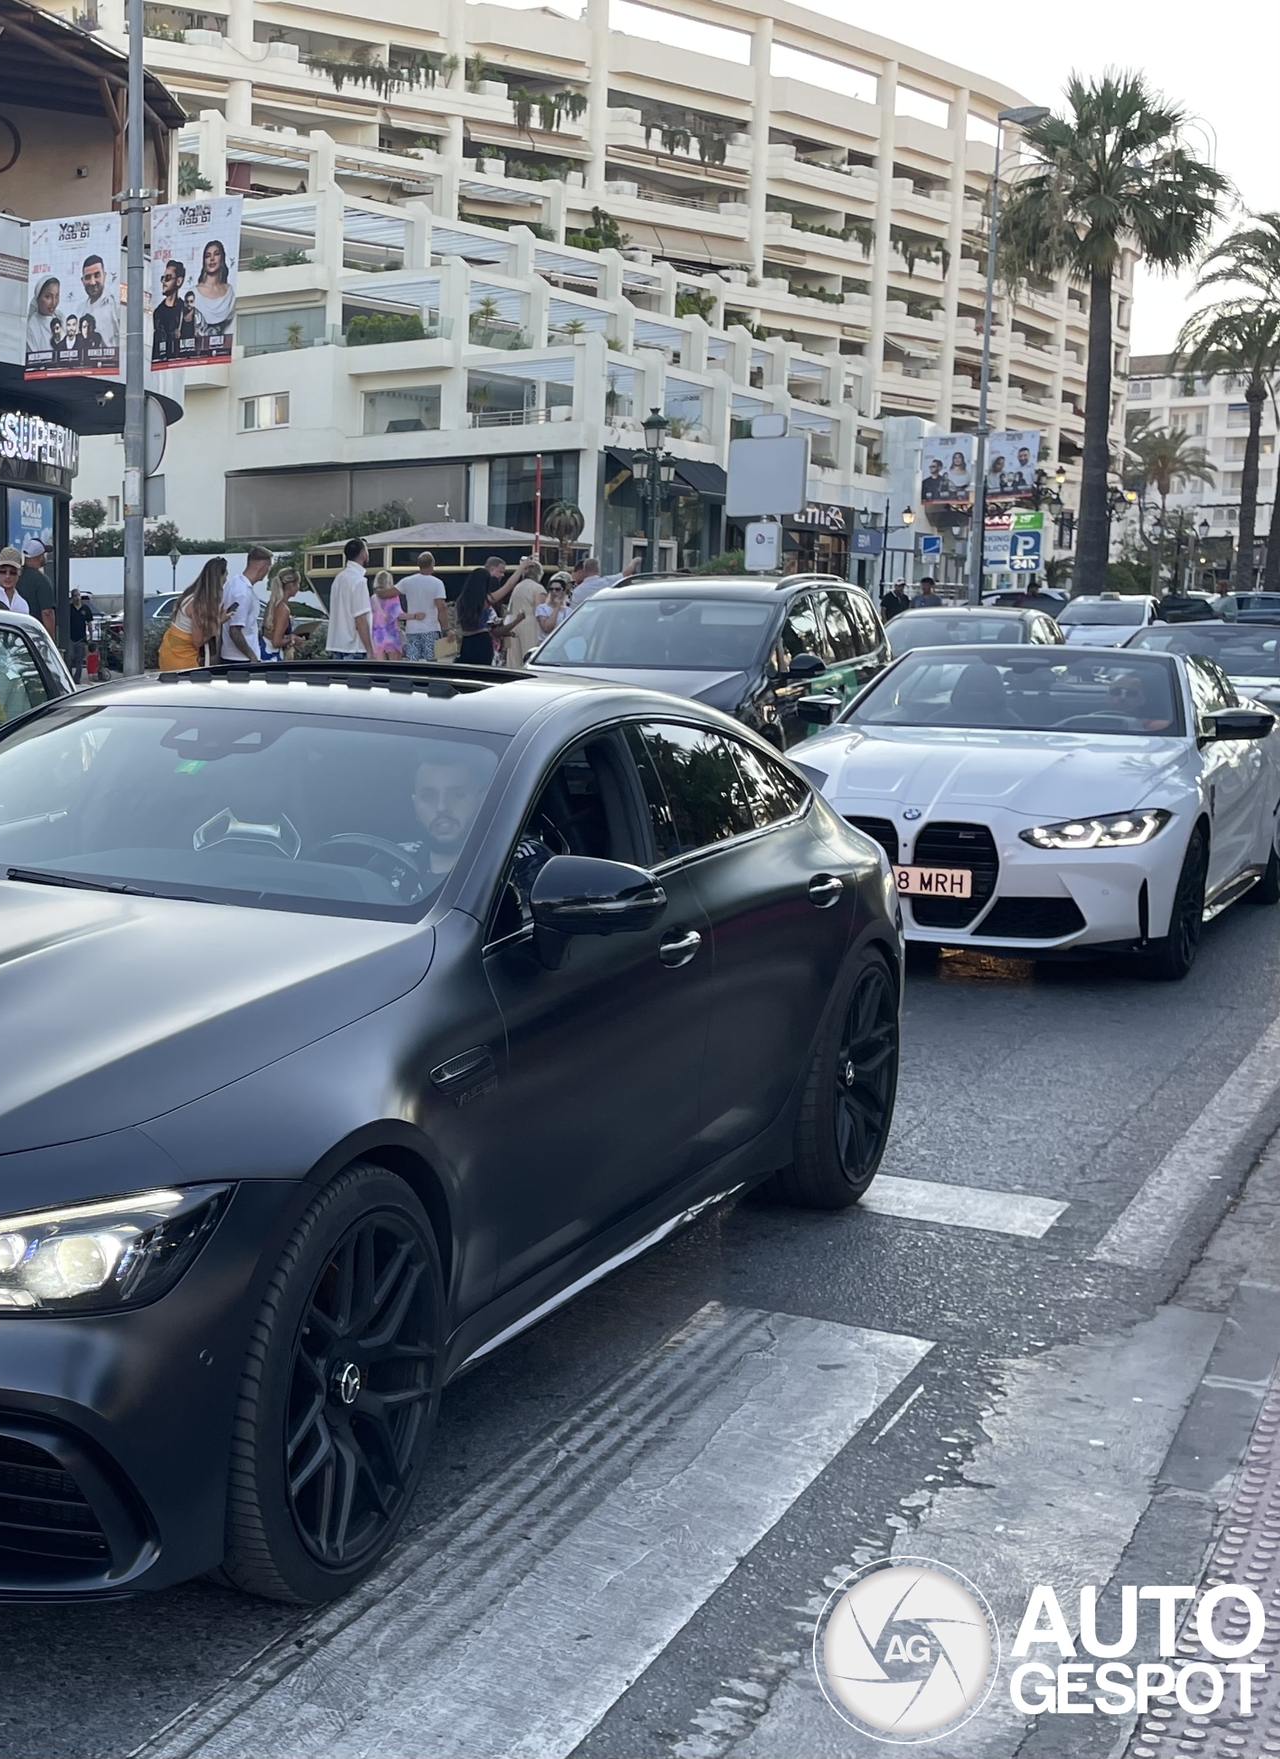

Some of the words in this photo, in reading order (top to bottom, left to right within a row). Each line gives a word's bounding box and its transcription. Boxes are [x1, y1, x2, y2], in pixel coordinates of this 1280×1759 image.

[20, 500, 43, 519] POLLO
[1013, 560, 1037, 570] 24h
[919, 872, 964, 893] MRH
